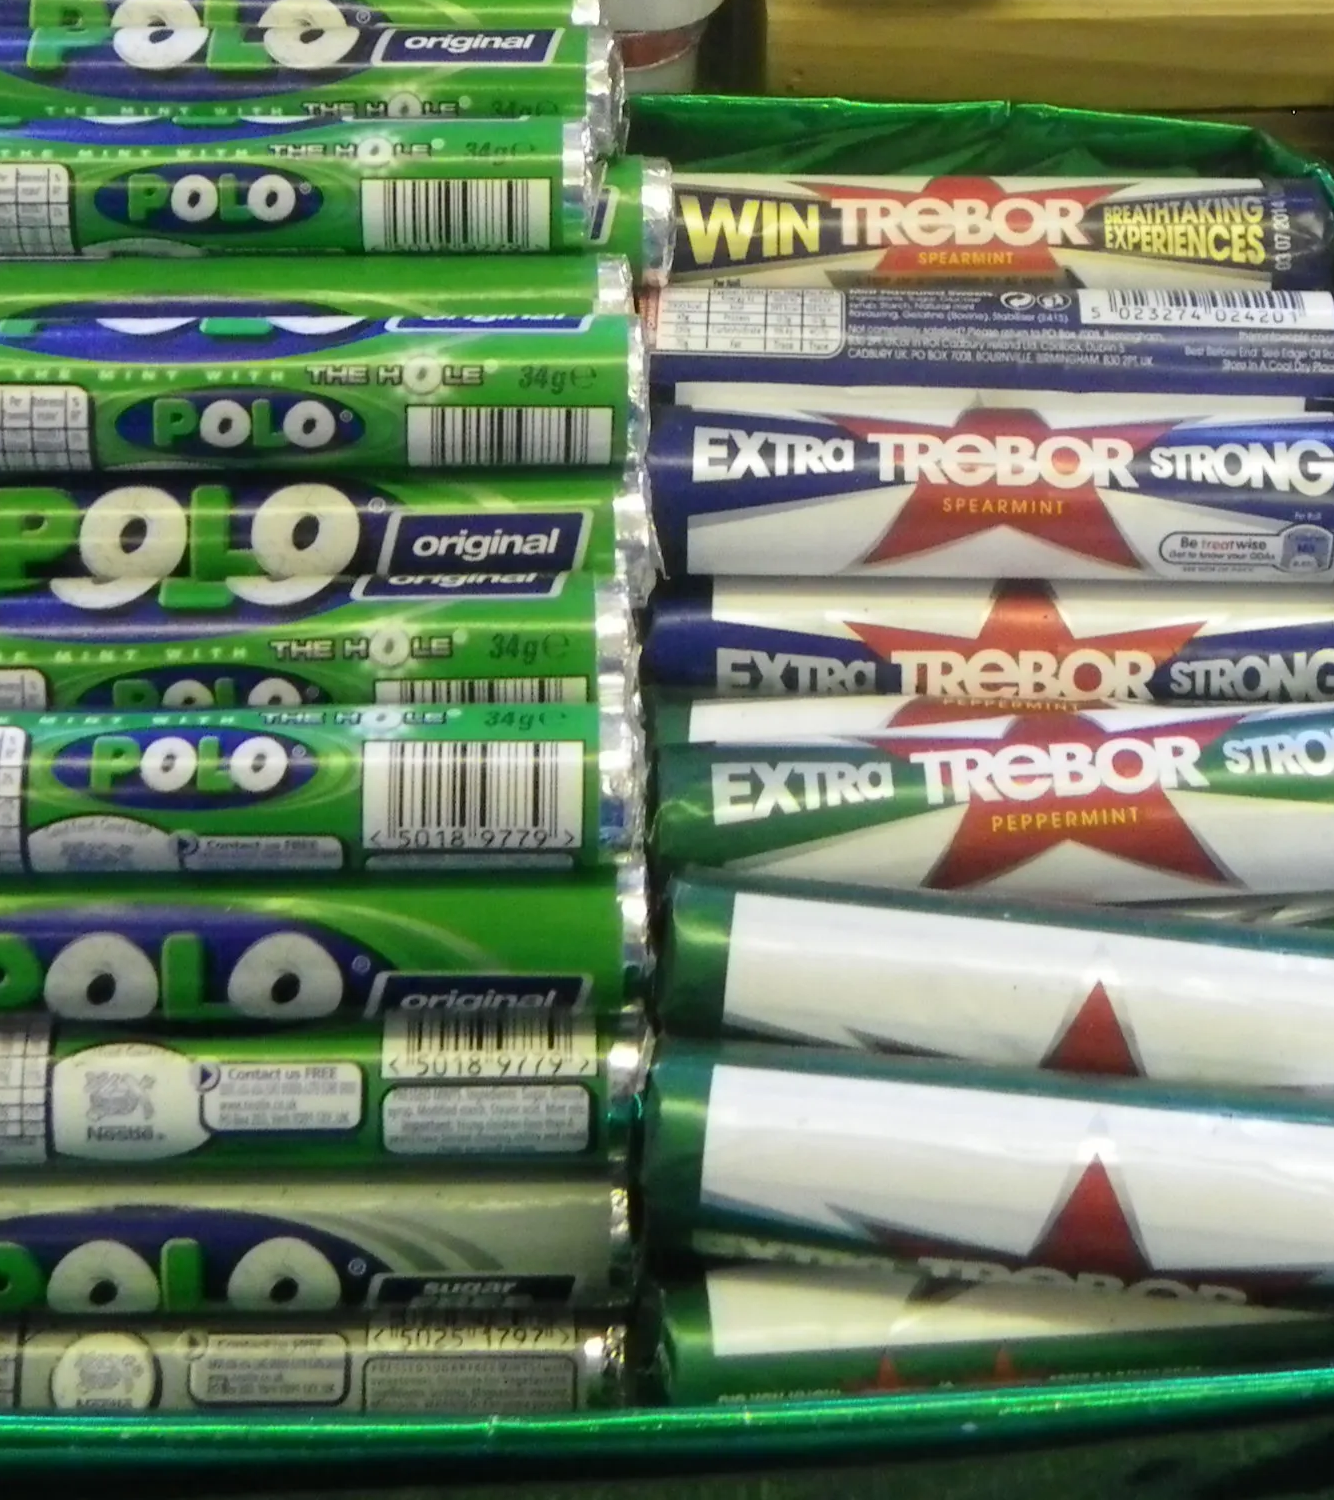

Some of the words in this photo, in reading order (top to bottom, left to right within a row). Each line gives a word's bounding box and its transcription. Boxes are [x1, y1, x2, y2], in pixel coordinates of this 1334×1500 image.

[404, 33, 536, 55] original
[128, 173, 297, 223] POLO
[679, 196, 821, 264] WIN
[1103, 195, 1265, 225] BREATHTAKING
[1104, 224, 1266, 265] EXPERIENCES
[917, 250, 1015, 266] SPEARMINT
[306, 364, 369, 386] THE
[376, 352, 485, 396] HOLE
[518, 365, 566, 394] 34g
[153, 397, 337, 448] POLO
[942, 496, 1065, 516] SPEARMINT
[411, 527, 560, 562] original
[1180, 536, 1198, 549] Be
[271, 638, 334, 662] THE
[342, 627, 453, 668] HOLE
[91, 735, 289, 793] POLO
[990, 805, 1142, 834] PEPPERMINT
[399, 988, 557, 1011] original
[227, 1067, 283, 1081] Contact
[304, 1066, 338, 1080] FREE
